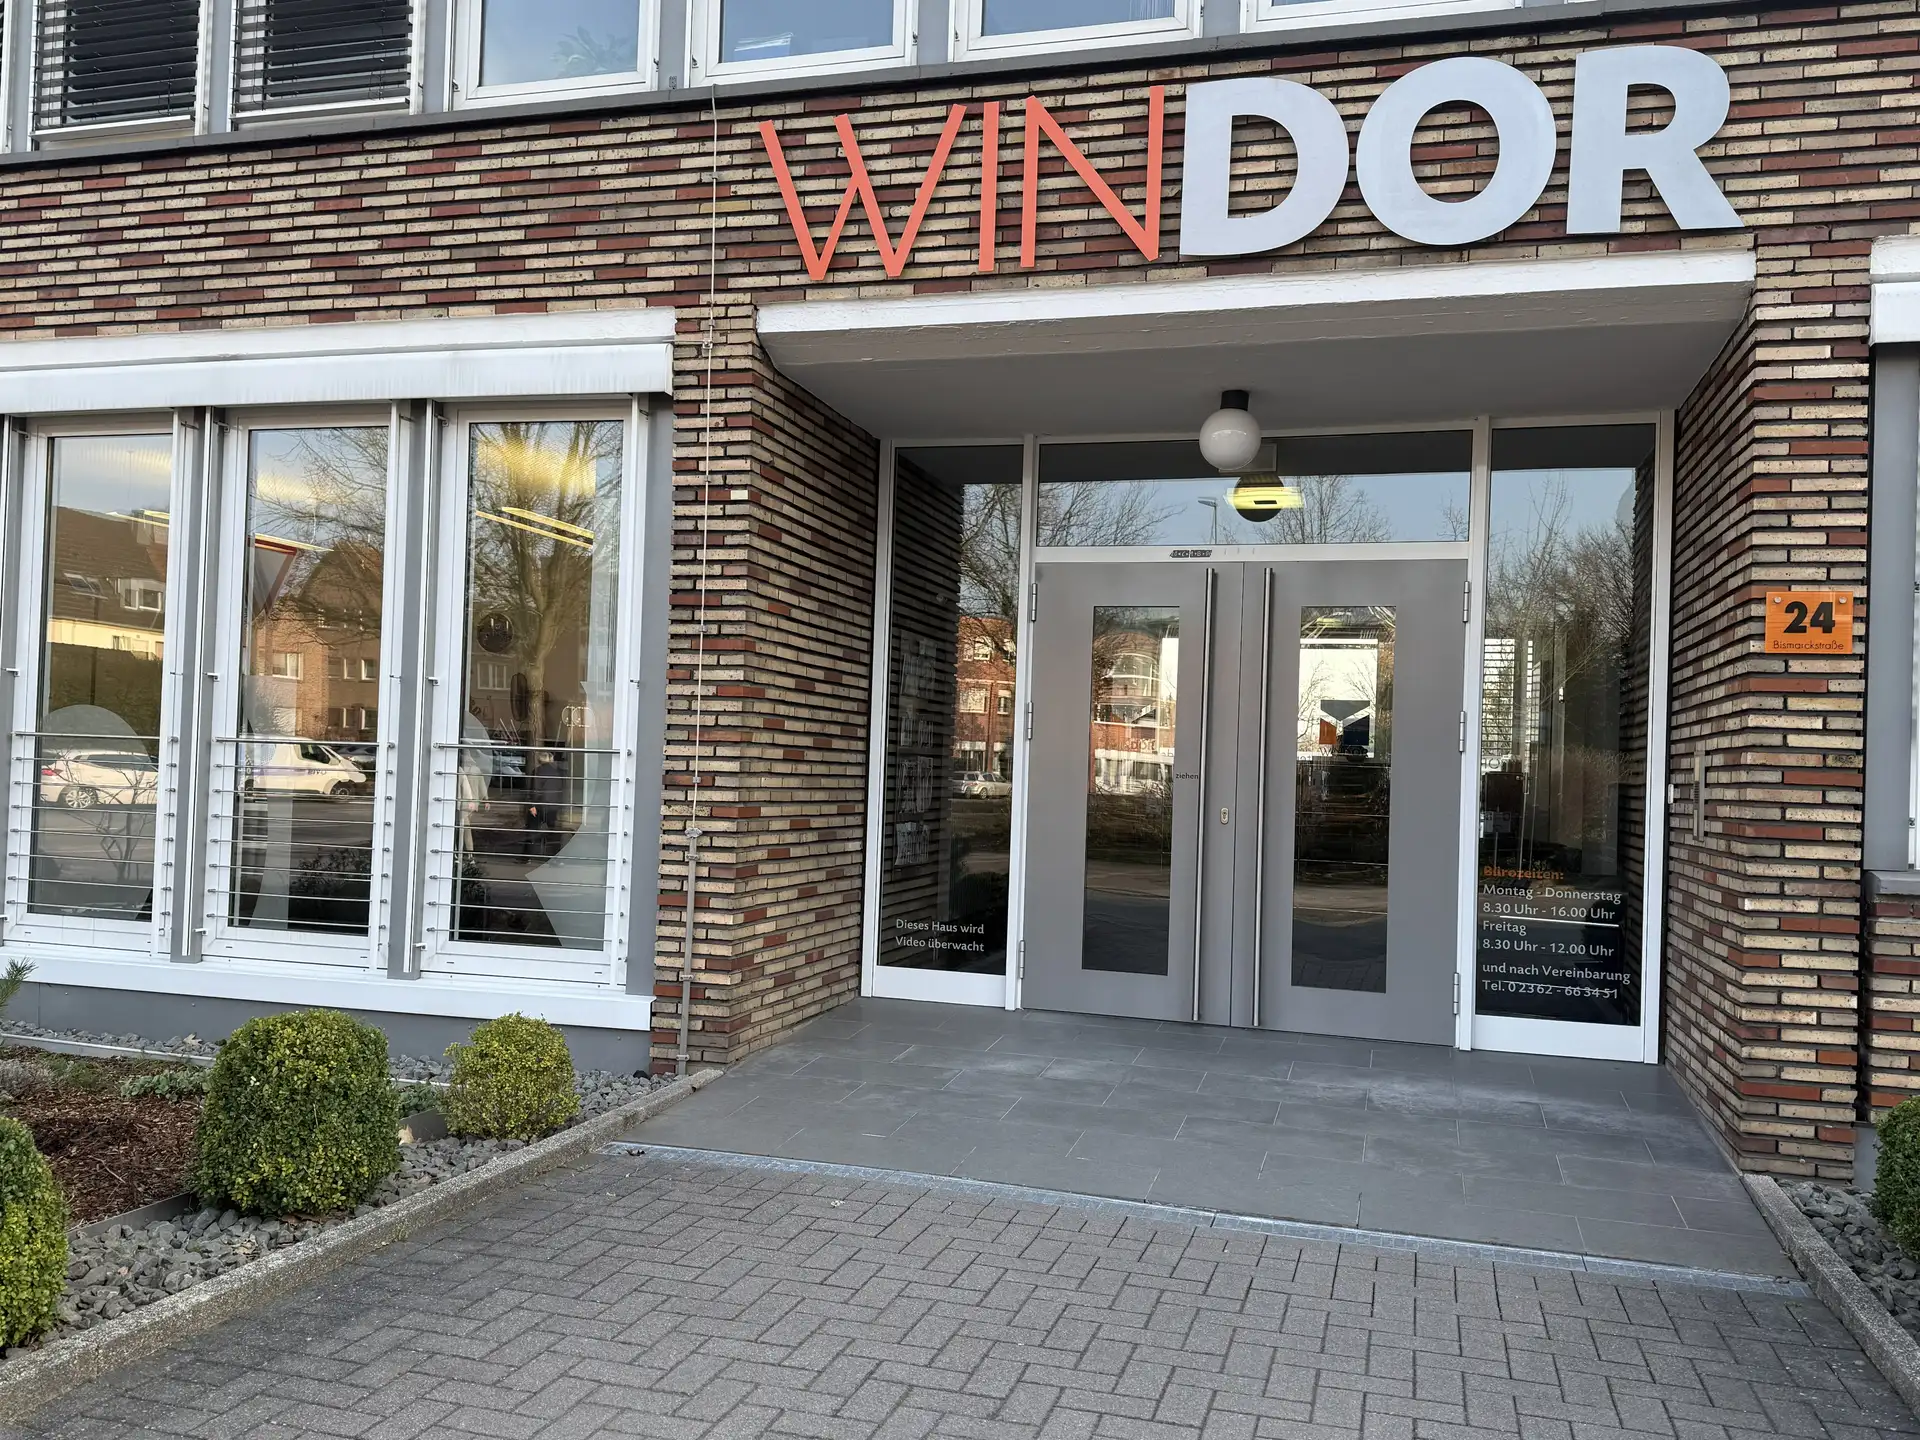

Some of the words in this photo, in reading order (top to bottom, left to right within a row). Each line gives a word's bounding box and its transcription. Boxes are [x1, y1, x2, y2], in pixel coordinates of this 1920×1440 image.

[758, 45, 1743, 281] WINDOR
[1783, 601, 1835, 634] 24
[1773, 640, 1844, 650] Bismarckstraße
[1483, 866, 1564, 880] Bürozeiten:
[1483, 884, 1533, 899] Montag
[1545, 887, 1622, 904] Donnerstag
[1483, 902, 1511, 914] 8.30
[1514, 903, 1539, 915] Uhr
[1551, 906, 1587, 918] 16.00
[1590, 907, 1615, 920] Uhr
[896, 919, 929, 931] Dieses
[931, 921, 958, 933] Haus
[960, 924, 985, 934] wird
[1483, 920, 1527, 936] Freitag
[896, 936, 926, 947] Video
[928, 939, 985, 951] überwacht
[1482, 939, 1511, 950] 8.30
[1514, 939, 1538, 951] Uhr
[1550, 943, 1586, 955] 12.00
[1589, 944, 1614, 957] Uhr
[1482, 963, 1506, 974] und
[1509, 963, 1539, 976] nach
[1541, 965, 1631, 985] Vereinbarung
[1482, 979, 1505, 992] Tel.
